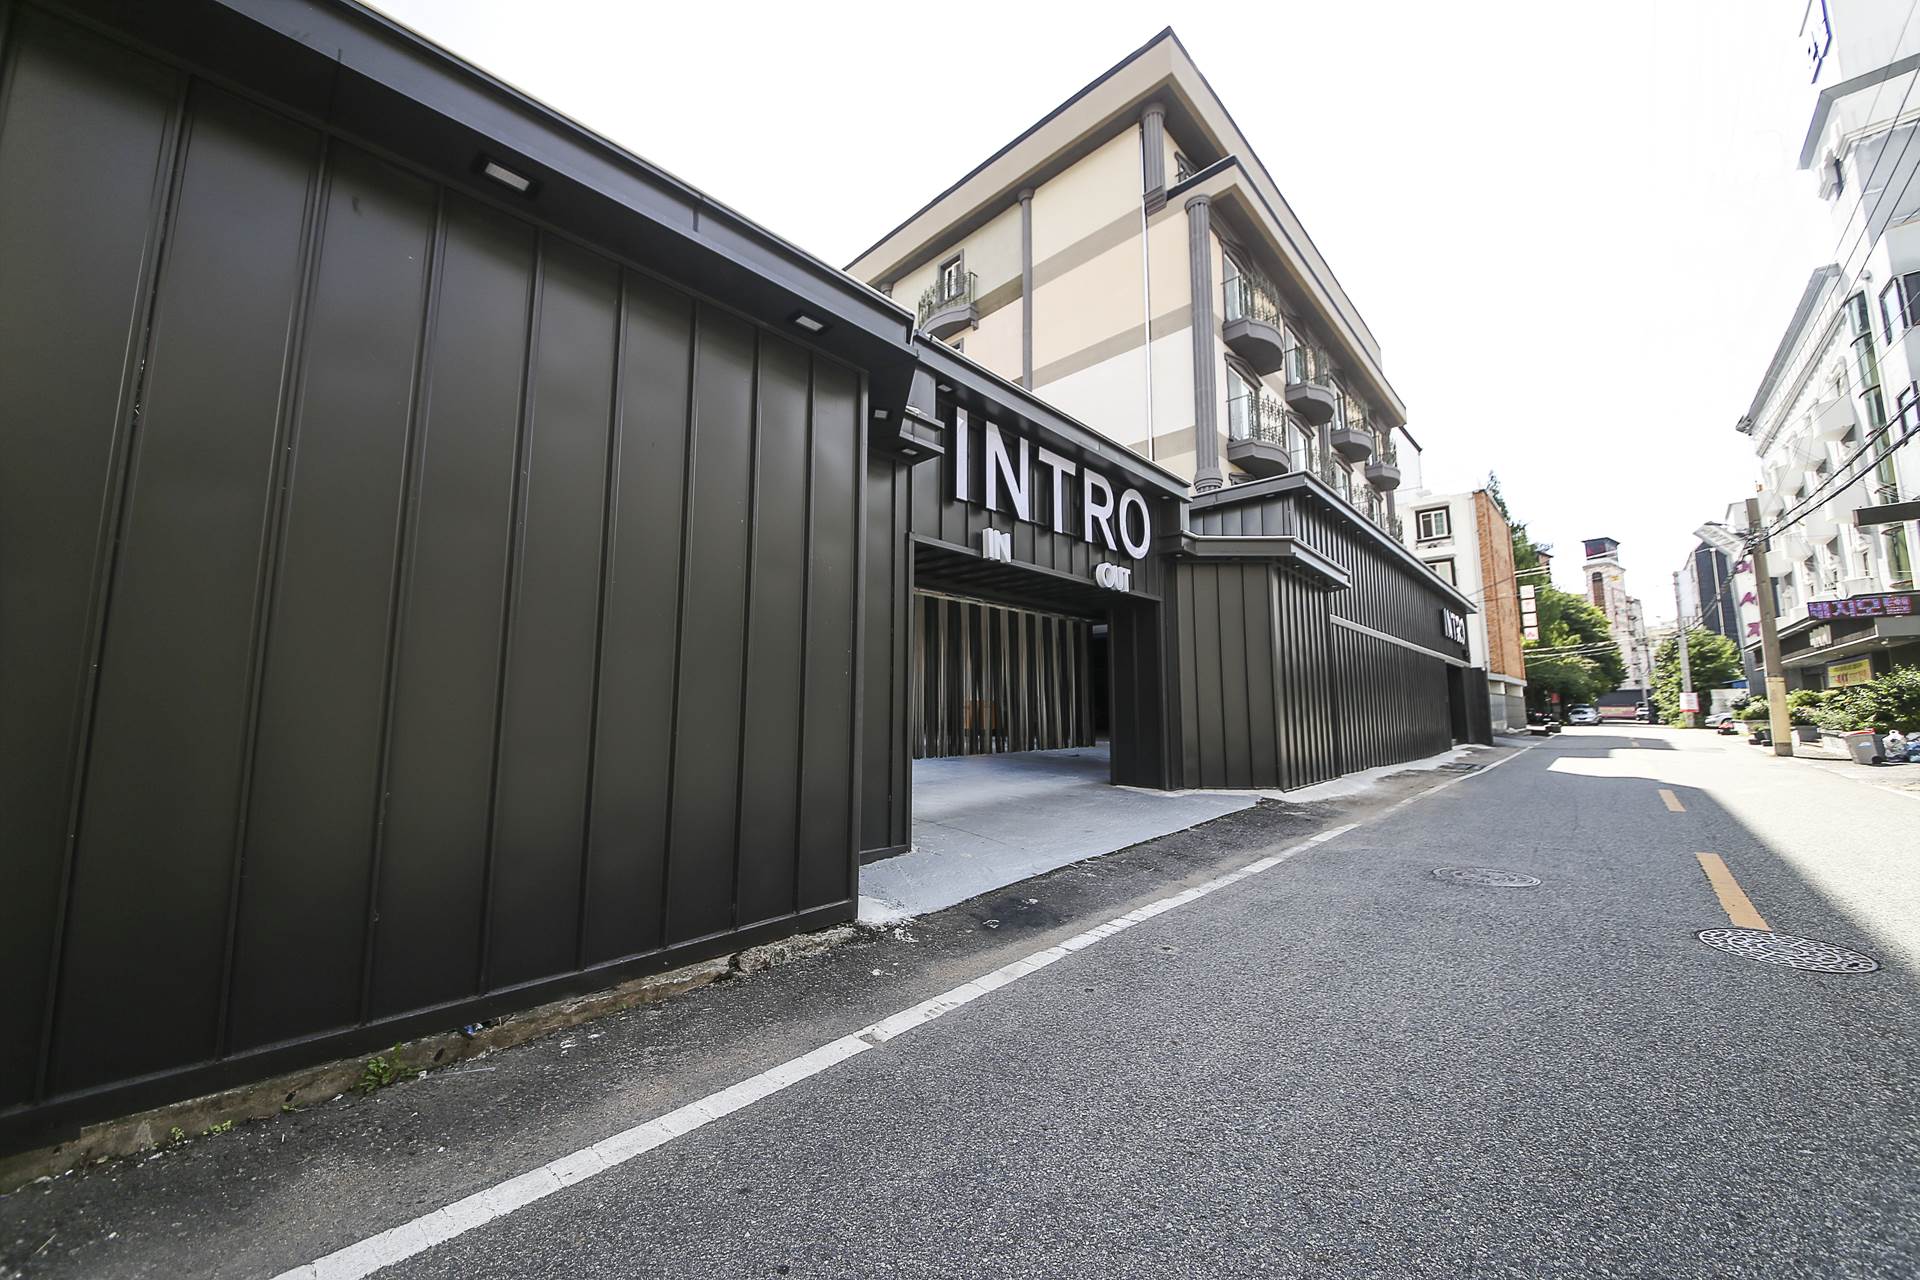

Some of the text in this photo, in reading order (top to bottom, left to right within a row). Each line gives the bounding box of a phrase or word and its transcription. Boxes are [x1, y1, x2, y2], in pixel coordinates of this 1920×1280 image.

[956, 406, 1151, 560] INTRO
[982, 527, 1012, 563] IN
[1095, 562, 1131, 593] OUT
